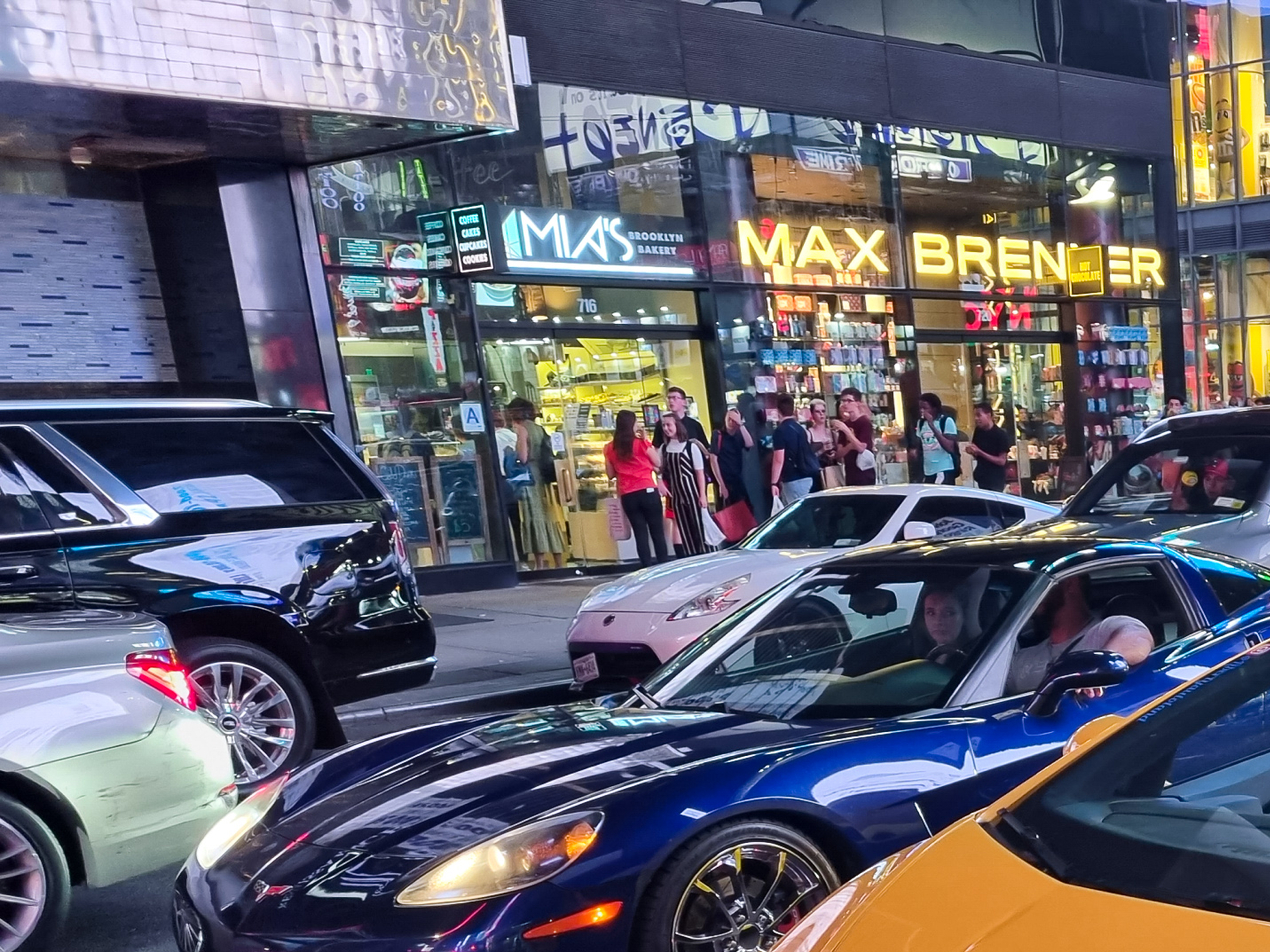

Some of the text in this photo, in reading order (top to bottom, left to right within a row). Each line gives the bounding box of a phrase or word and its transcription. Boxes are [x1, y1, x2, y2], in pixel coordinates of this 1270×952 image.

[459, 214, 479, 225] COFFEE
[461, 227, 481, 238] CAKES
[519, 210, 634, 262] MIA'S
[628, 231, 684, 243] BROOKLYN
[460, 240, 487, 252] CUPCAKES
[638, 244, 677, 256] BAKERY
[737, 219, 1165, 286] MAX BRENER
[463, 253, 488, 265] COOKIES
[576, 298, 597, 313] 716
[466, 408, 479, 424] A
